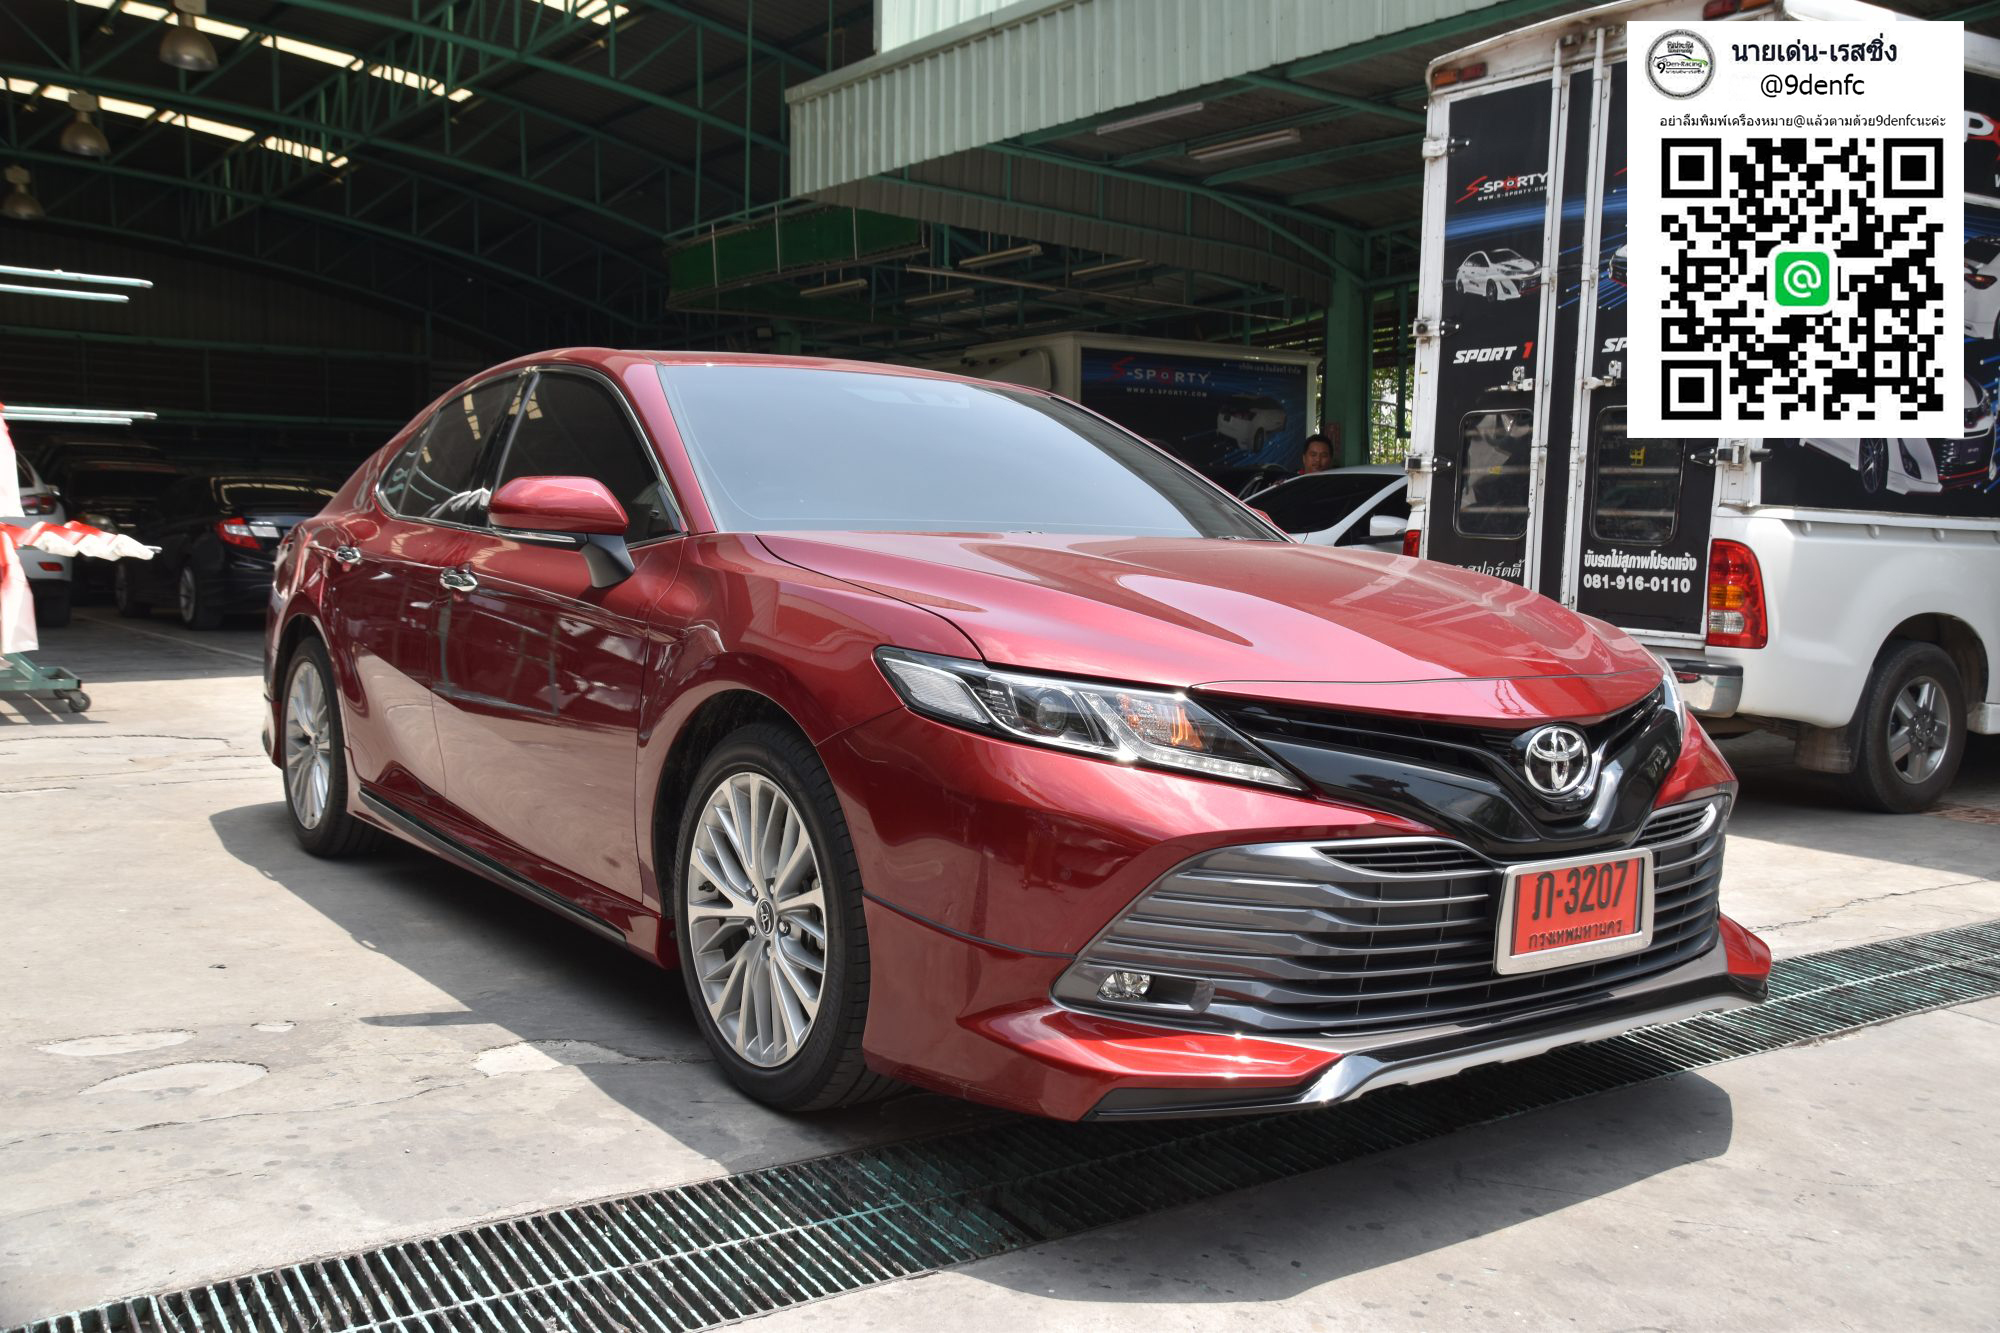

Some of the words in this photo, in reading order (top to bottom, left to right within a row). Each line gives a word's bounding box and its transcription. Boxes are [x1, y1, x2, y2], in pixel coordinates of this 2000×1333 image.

[1456, 173, 1549, 203] S-SPORTY
[1453, 346, 1517, 364] SPORT
[1522, 341, 1534, 360] 1
[1104, 355, 1209, 384] S-SPORTY
[1584, 548, 1697, 574] ขับรถไม่สุภาพโปรดแจ้ง
[1583, 573, 1691, 593] 081-916-0110
